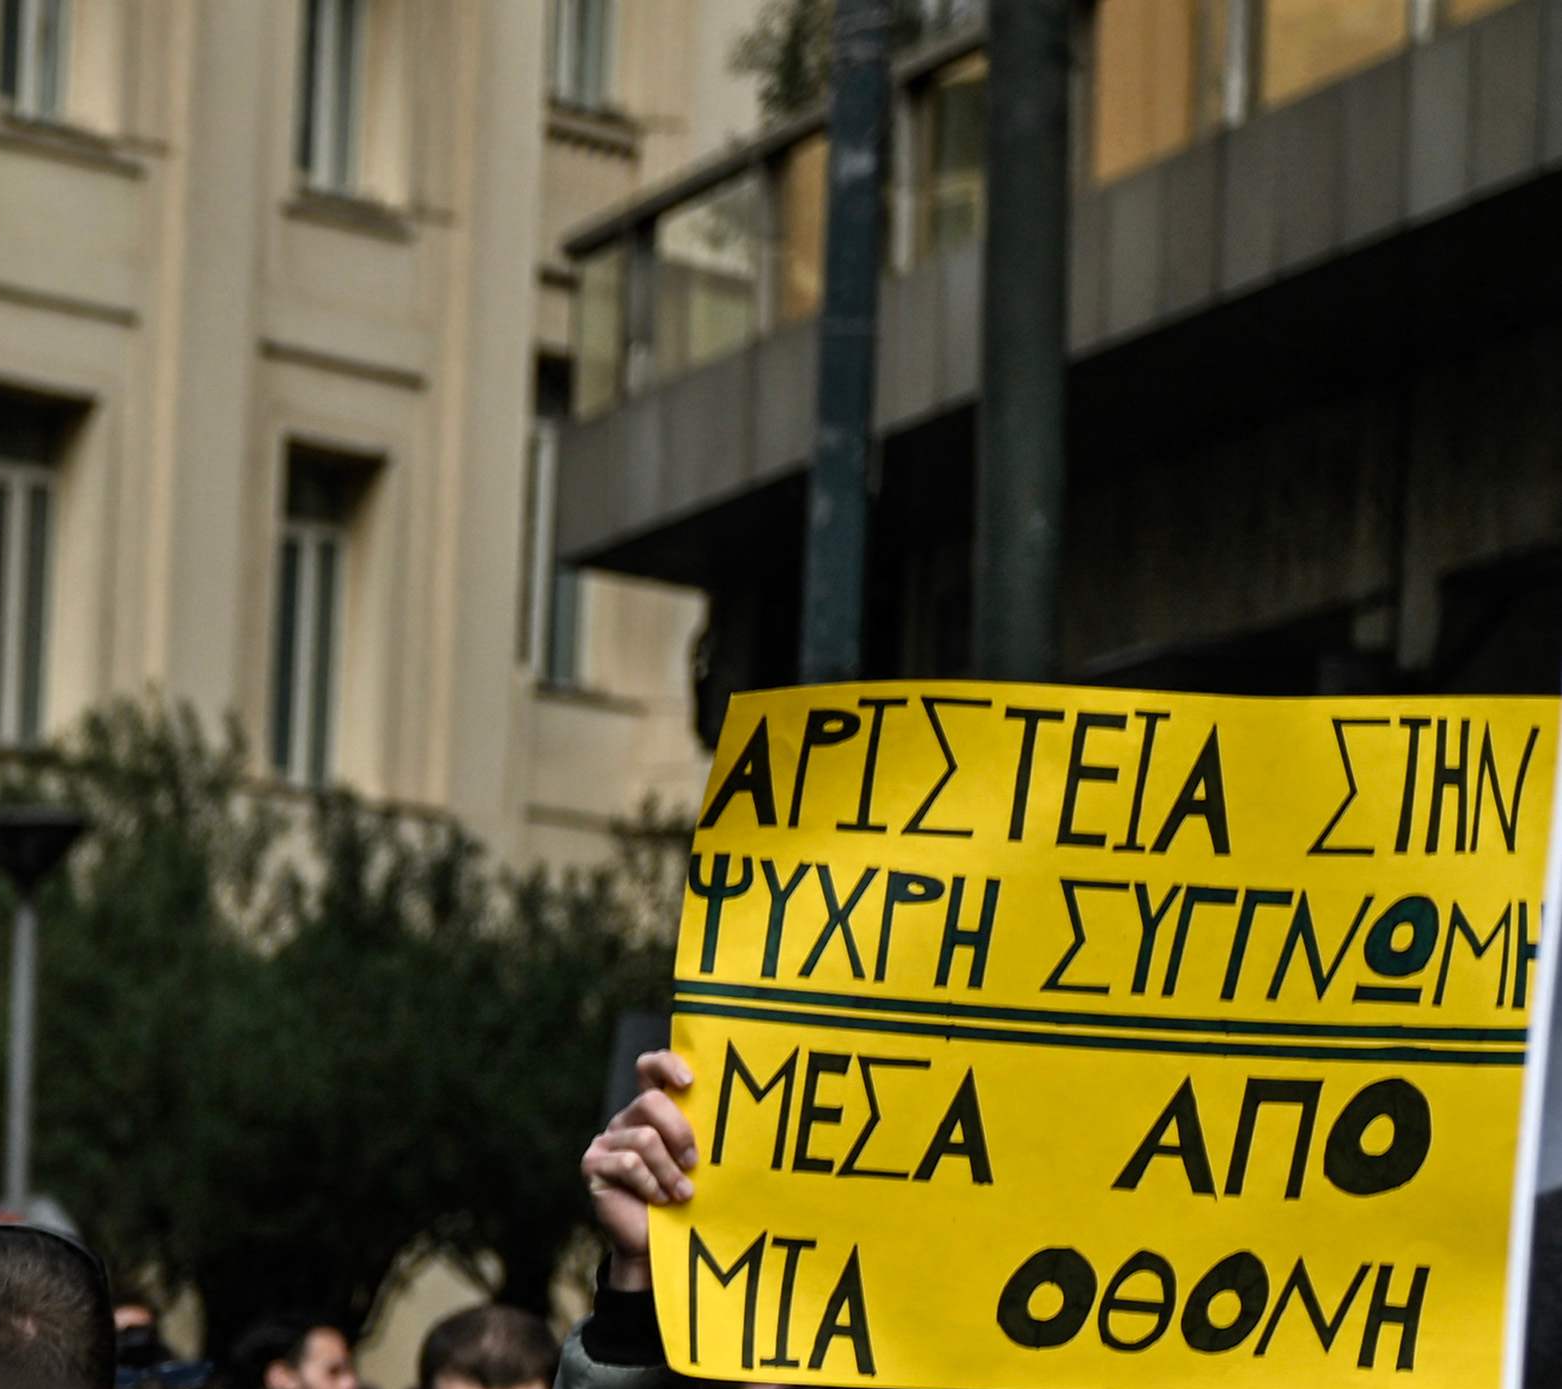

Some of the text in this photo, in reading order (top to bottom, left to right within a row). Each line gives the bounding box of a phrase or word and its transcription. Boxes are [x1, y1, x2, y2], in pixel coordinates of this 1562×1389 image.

[700, 696, 1540, 857] ΑΡΙΣΤΕΙΑ ΣΤΗΝ
[687, 853, 1544, 1009] ΨΥΧΡΗ ΣΥΓΓΝΩΜΗ
[710, 1039, 1433, 1200] ΜΕΣΑ ΑΠΟ
[686, 1228, 1432, 1378] ΜΙΑ ΟΘΟΝΗ
